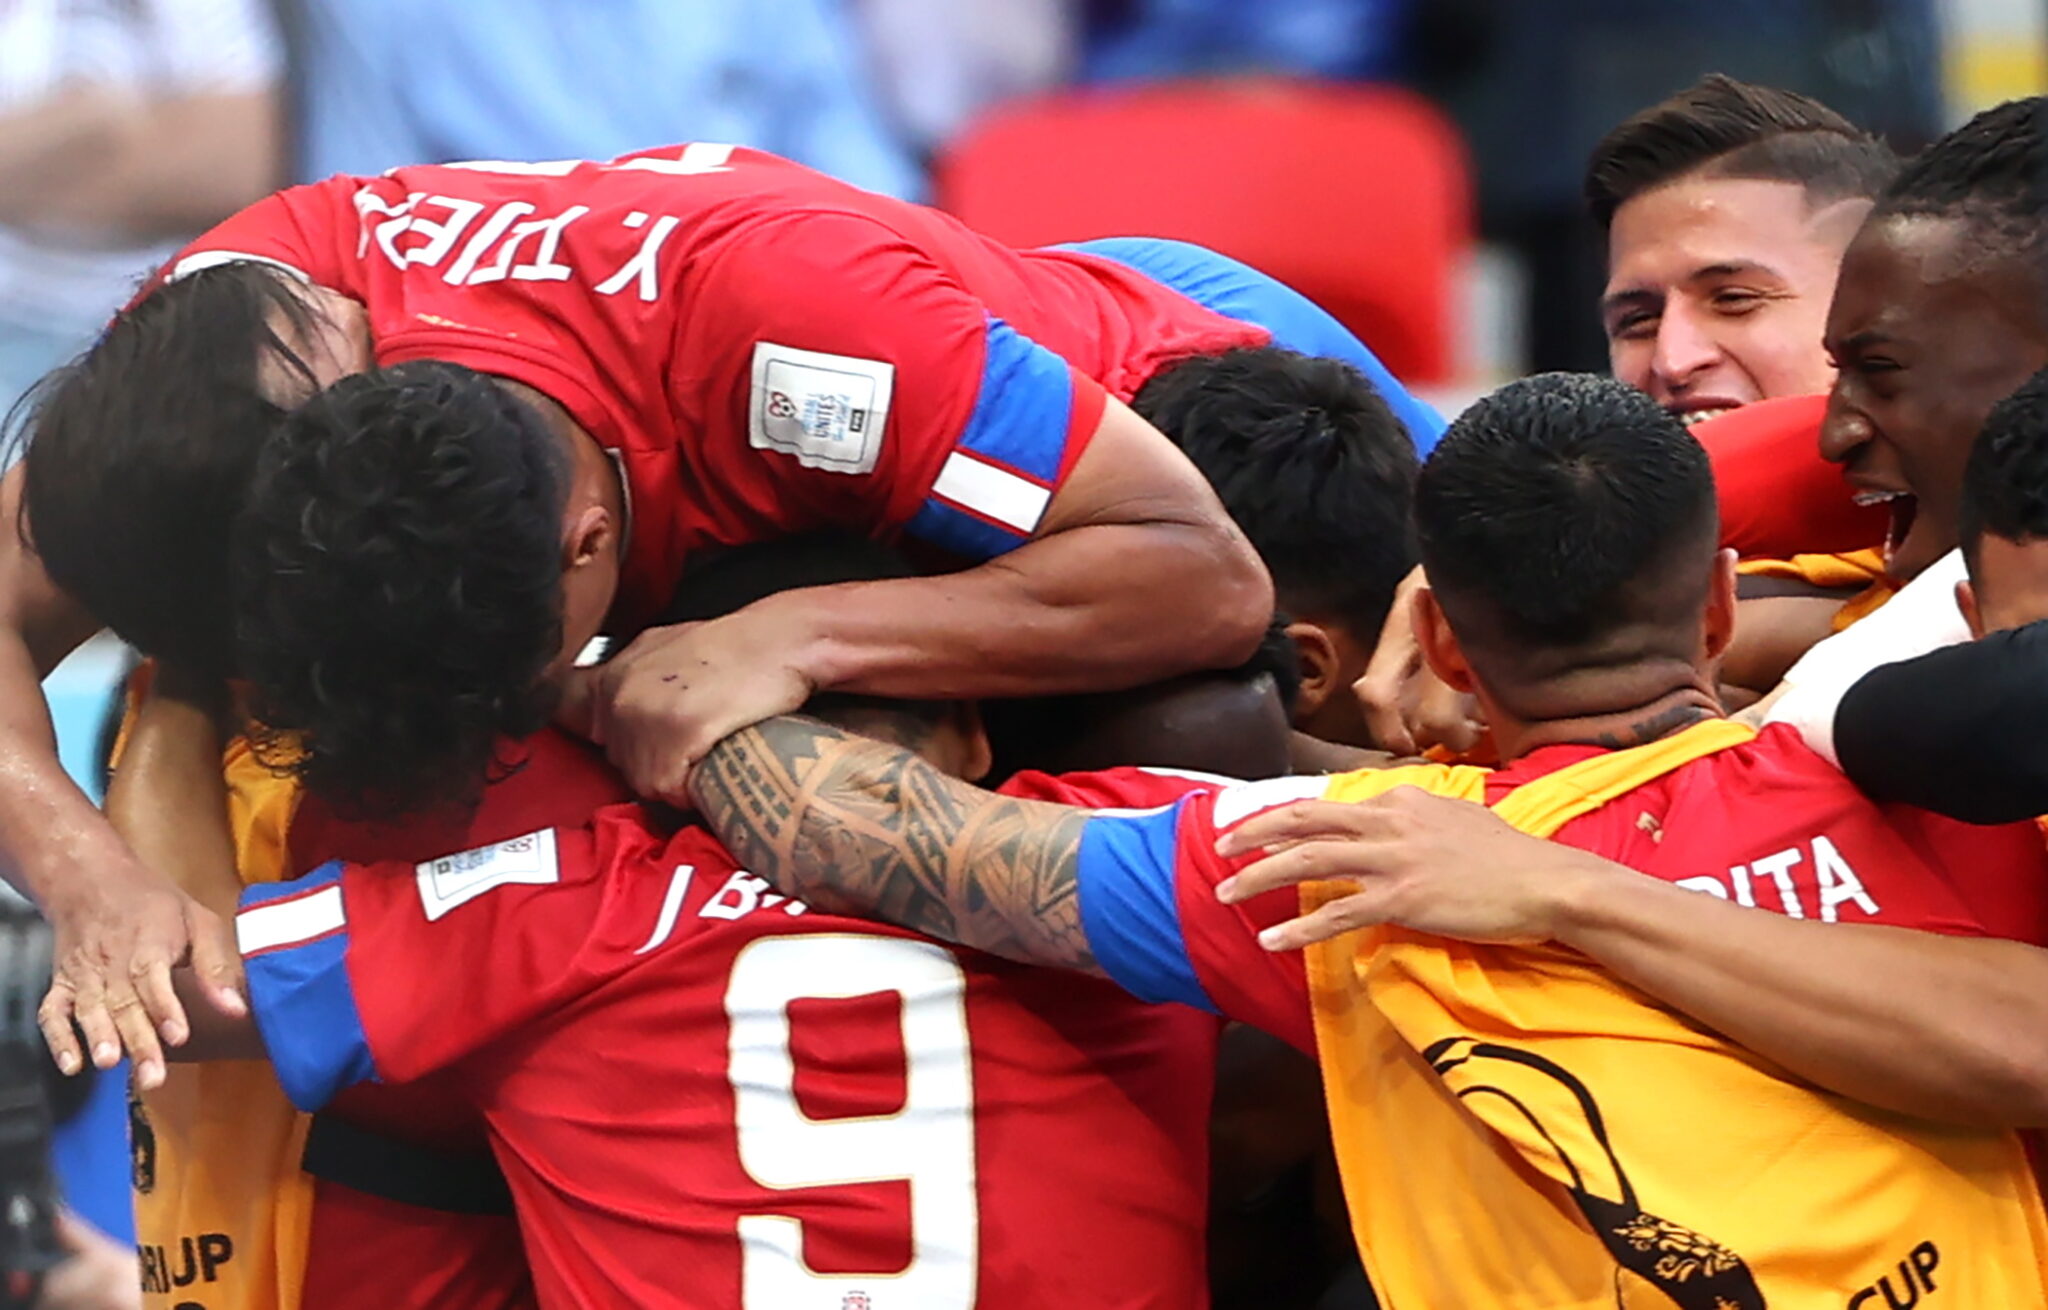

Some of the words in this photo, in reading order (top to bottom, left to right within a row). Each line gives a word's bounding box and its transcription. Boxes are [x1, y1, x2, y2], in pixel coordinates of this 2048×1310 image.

[594, 210, 680, 301] Y.
[1674, 835, 1880, 923] ITA
[724, 932, 978, 1310] 9
